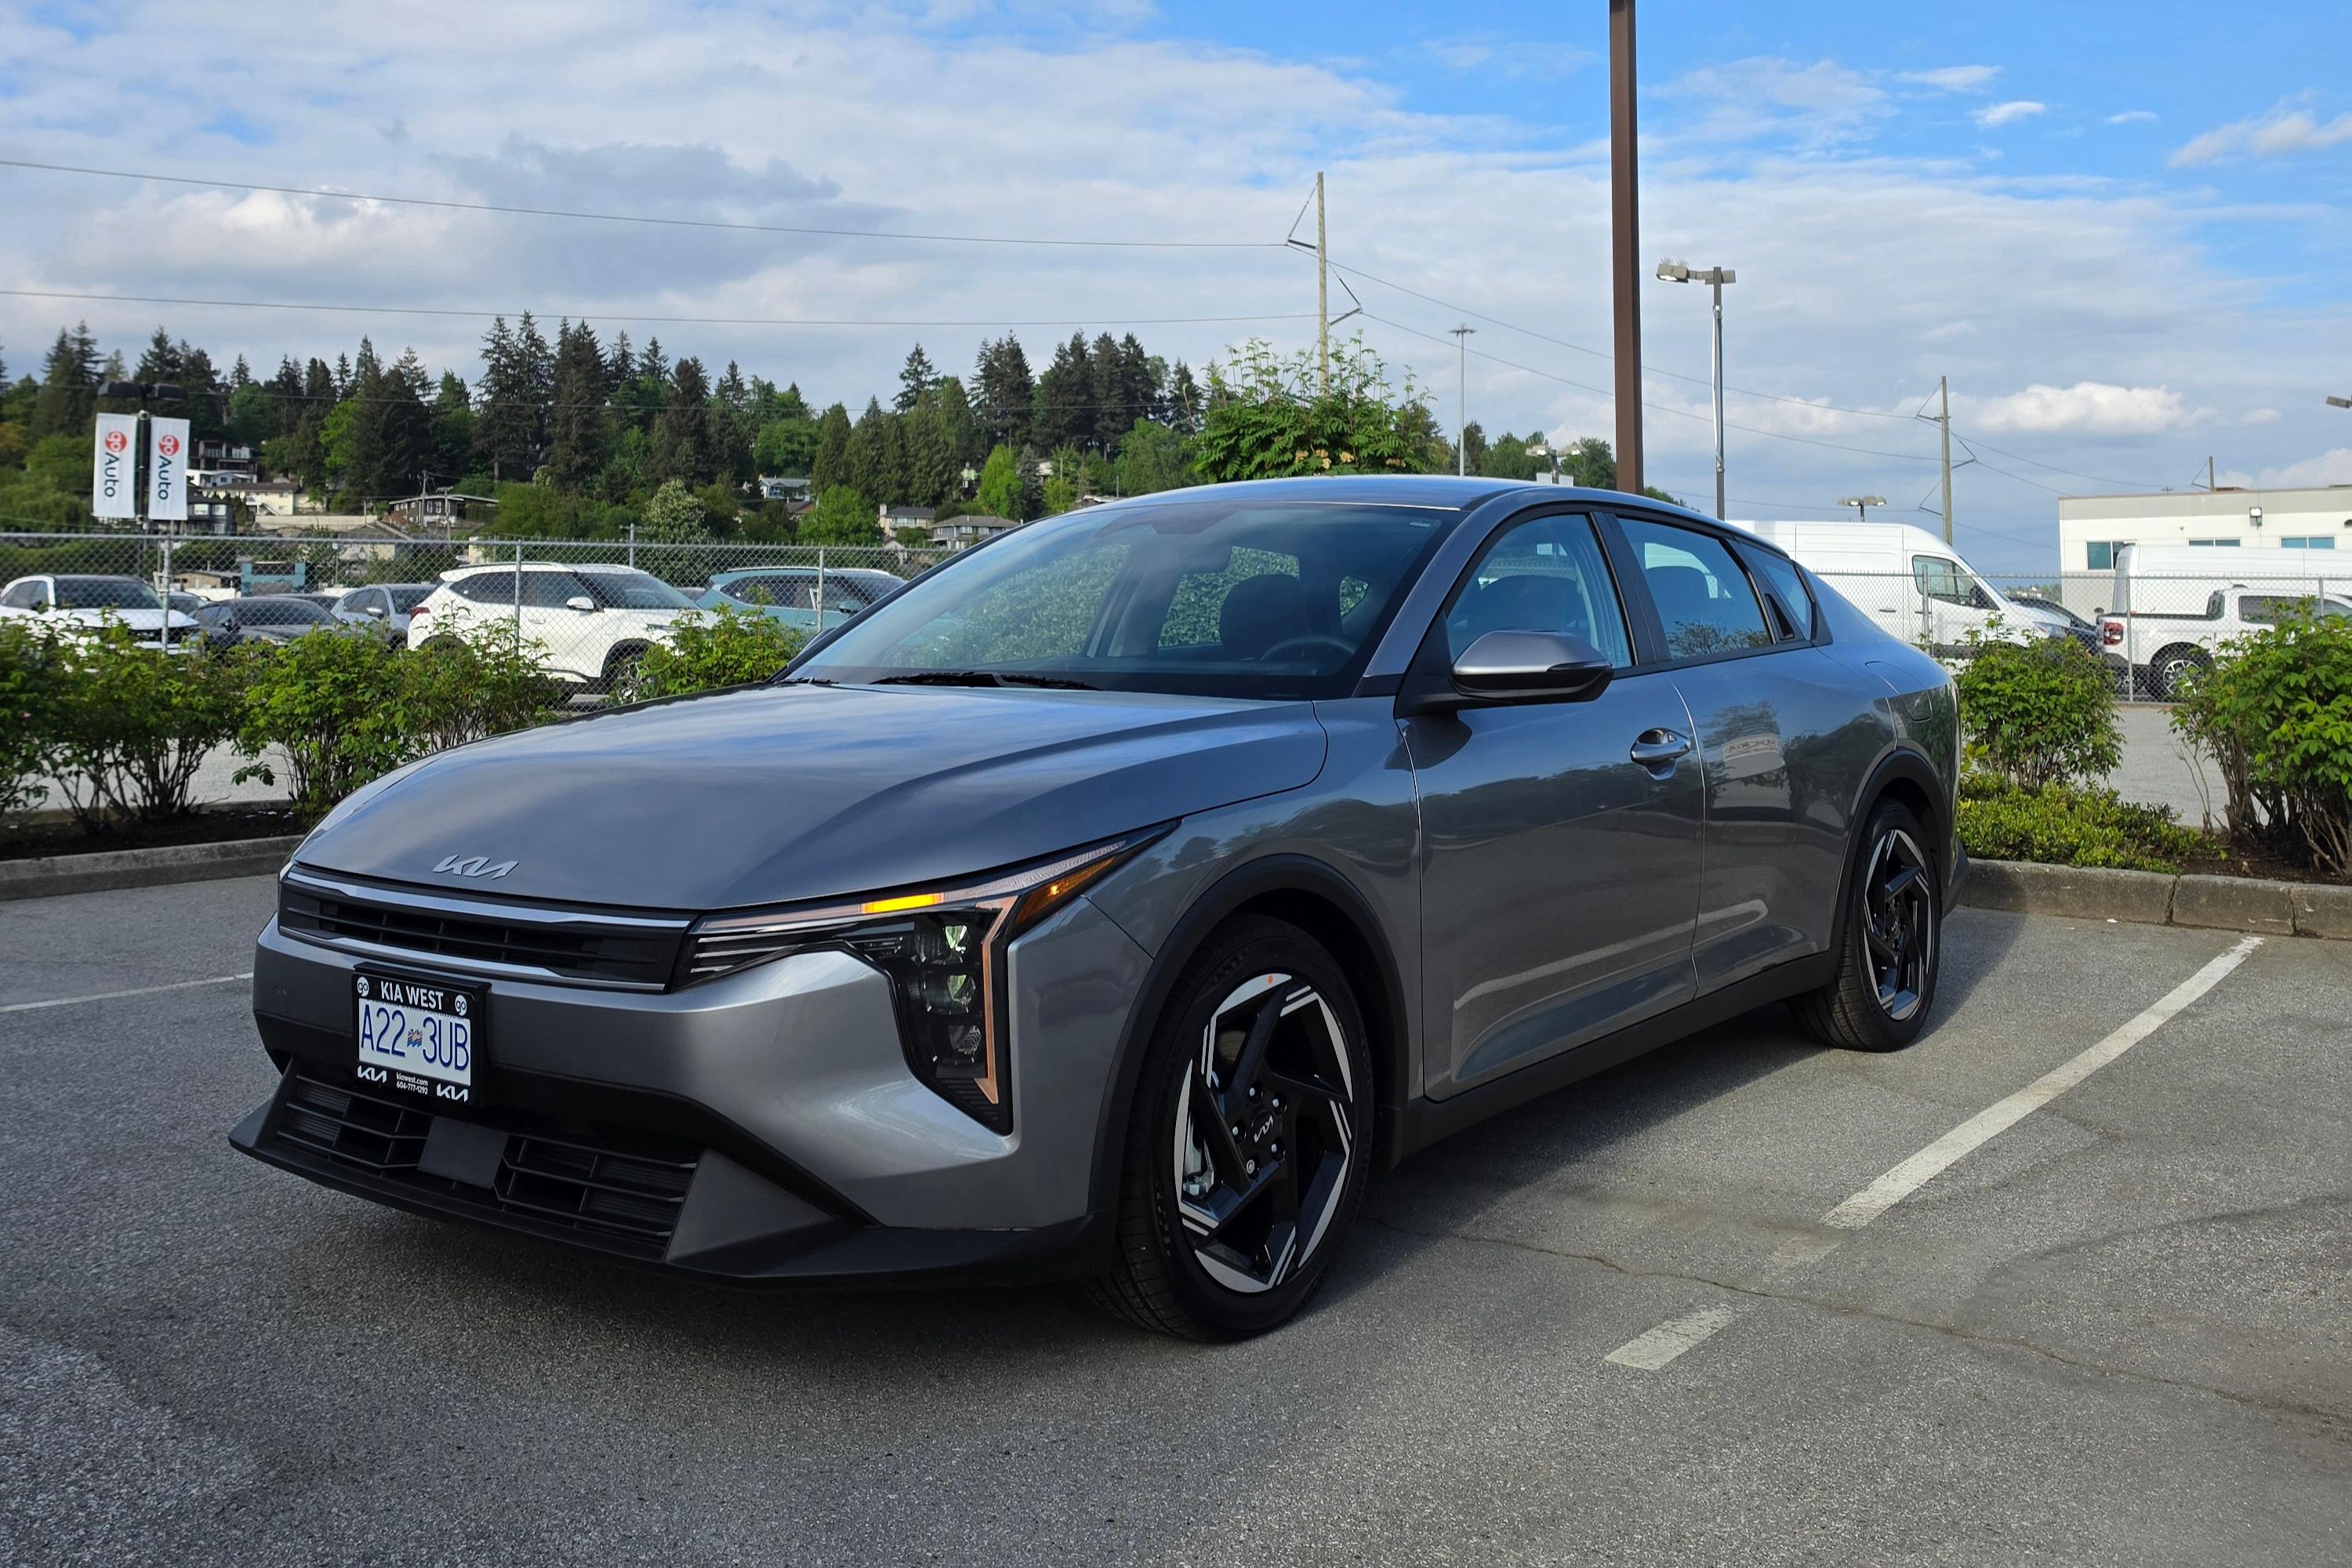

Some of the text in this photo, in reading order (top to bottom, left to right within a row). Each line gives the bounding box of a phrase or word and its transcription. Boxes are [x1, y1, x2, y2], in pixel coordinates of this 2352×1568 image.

[104, 452, 120, 497] Auto
[158, 456, 172, 500] Auto
[433, 854, 519, 880] KIA
[380, 981, 403, 1004] KIA
[406, 985, 444, 1010] WEST
[361, 1004, 469, 1071] A22 3UB
[358, 1065, 387, 1083] KIA
[436, 1083, 468, 1102] KIA
